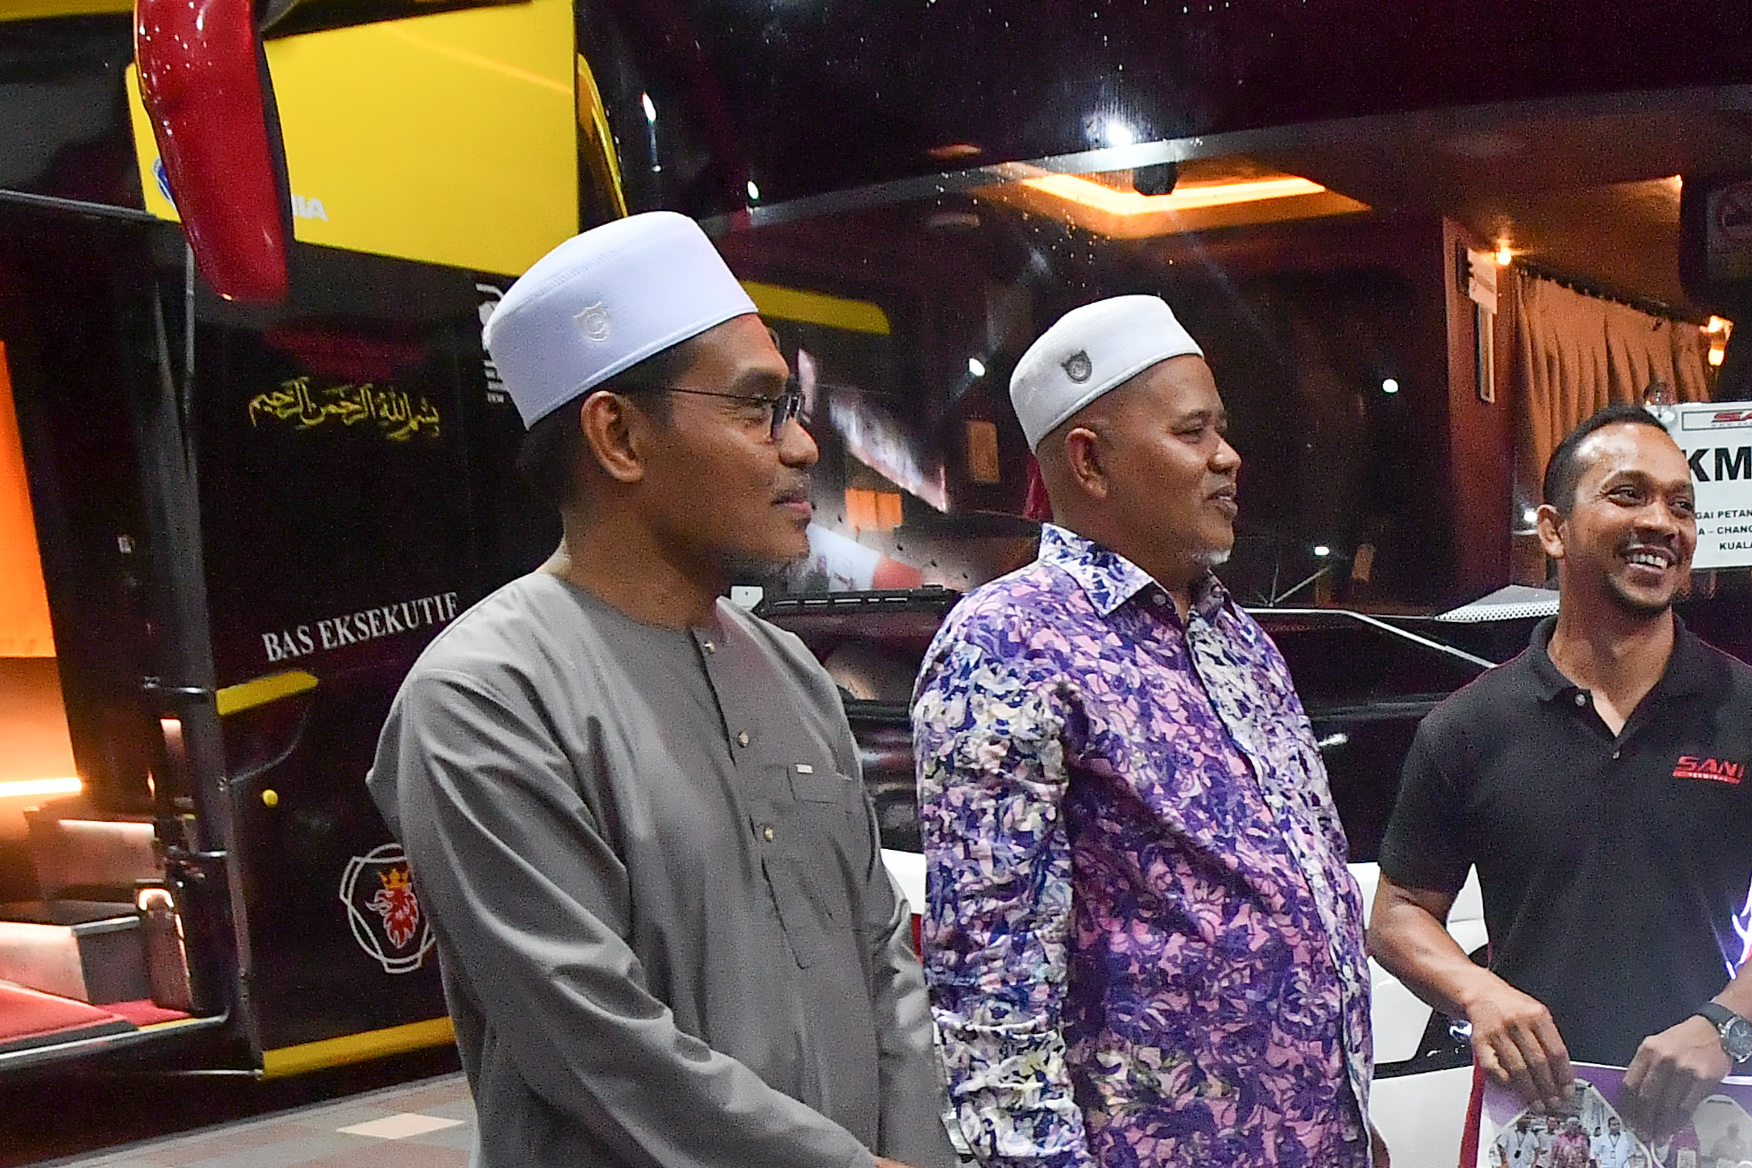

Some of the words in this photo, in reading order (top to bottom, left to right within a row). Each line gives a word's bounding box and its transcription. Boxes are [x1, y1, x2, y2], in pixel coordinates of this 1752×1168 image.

[1695, 511, 1715, 520] GAI
[261, 624, 315, 662] BAS
[316, 591, 459, 651] EKSEKUTIF
[1675, 755, 1746, 779] SANI
